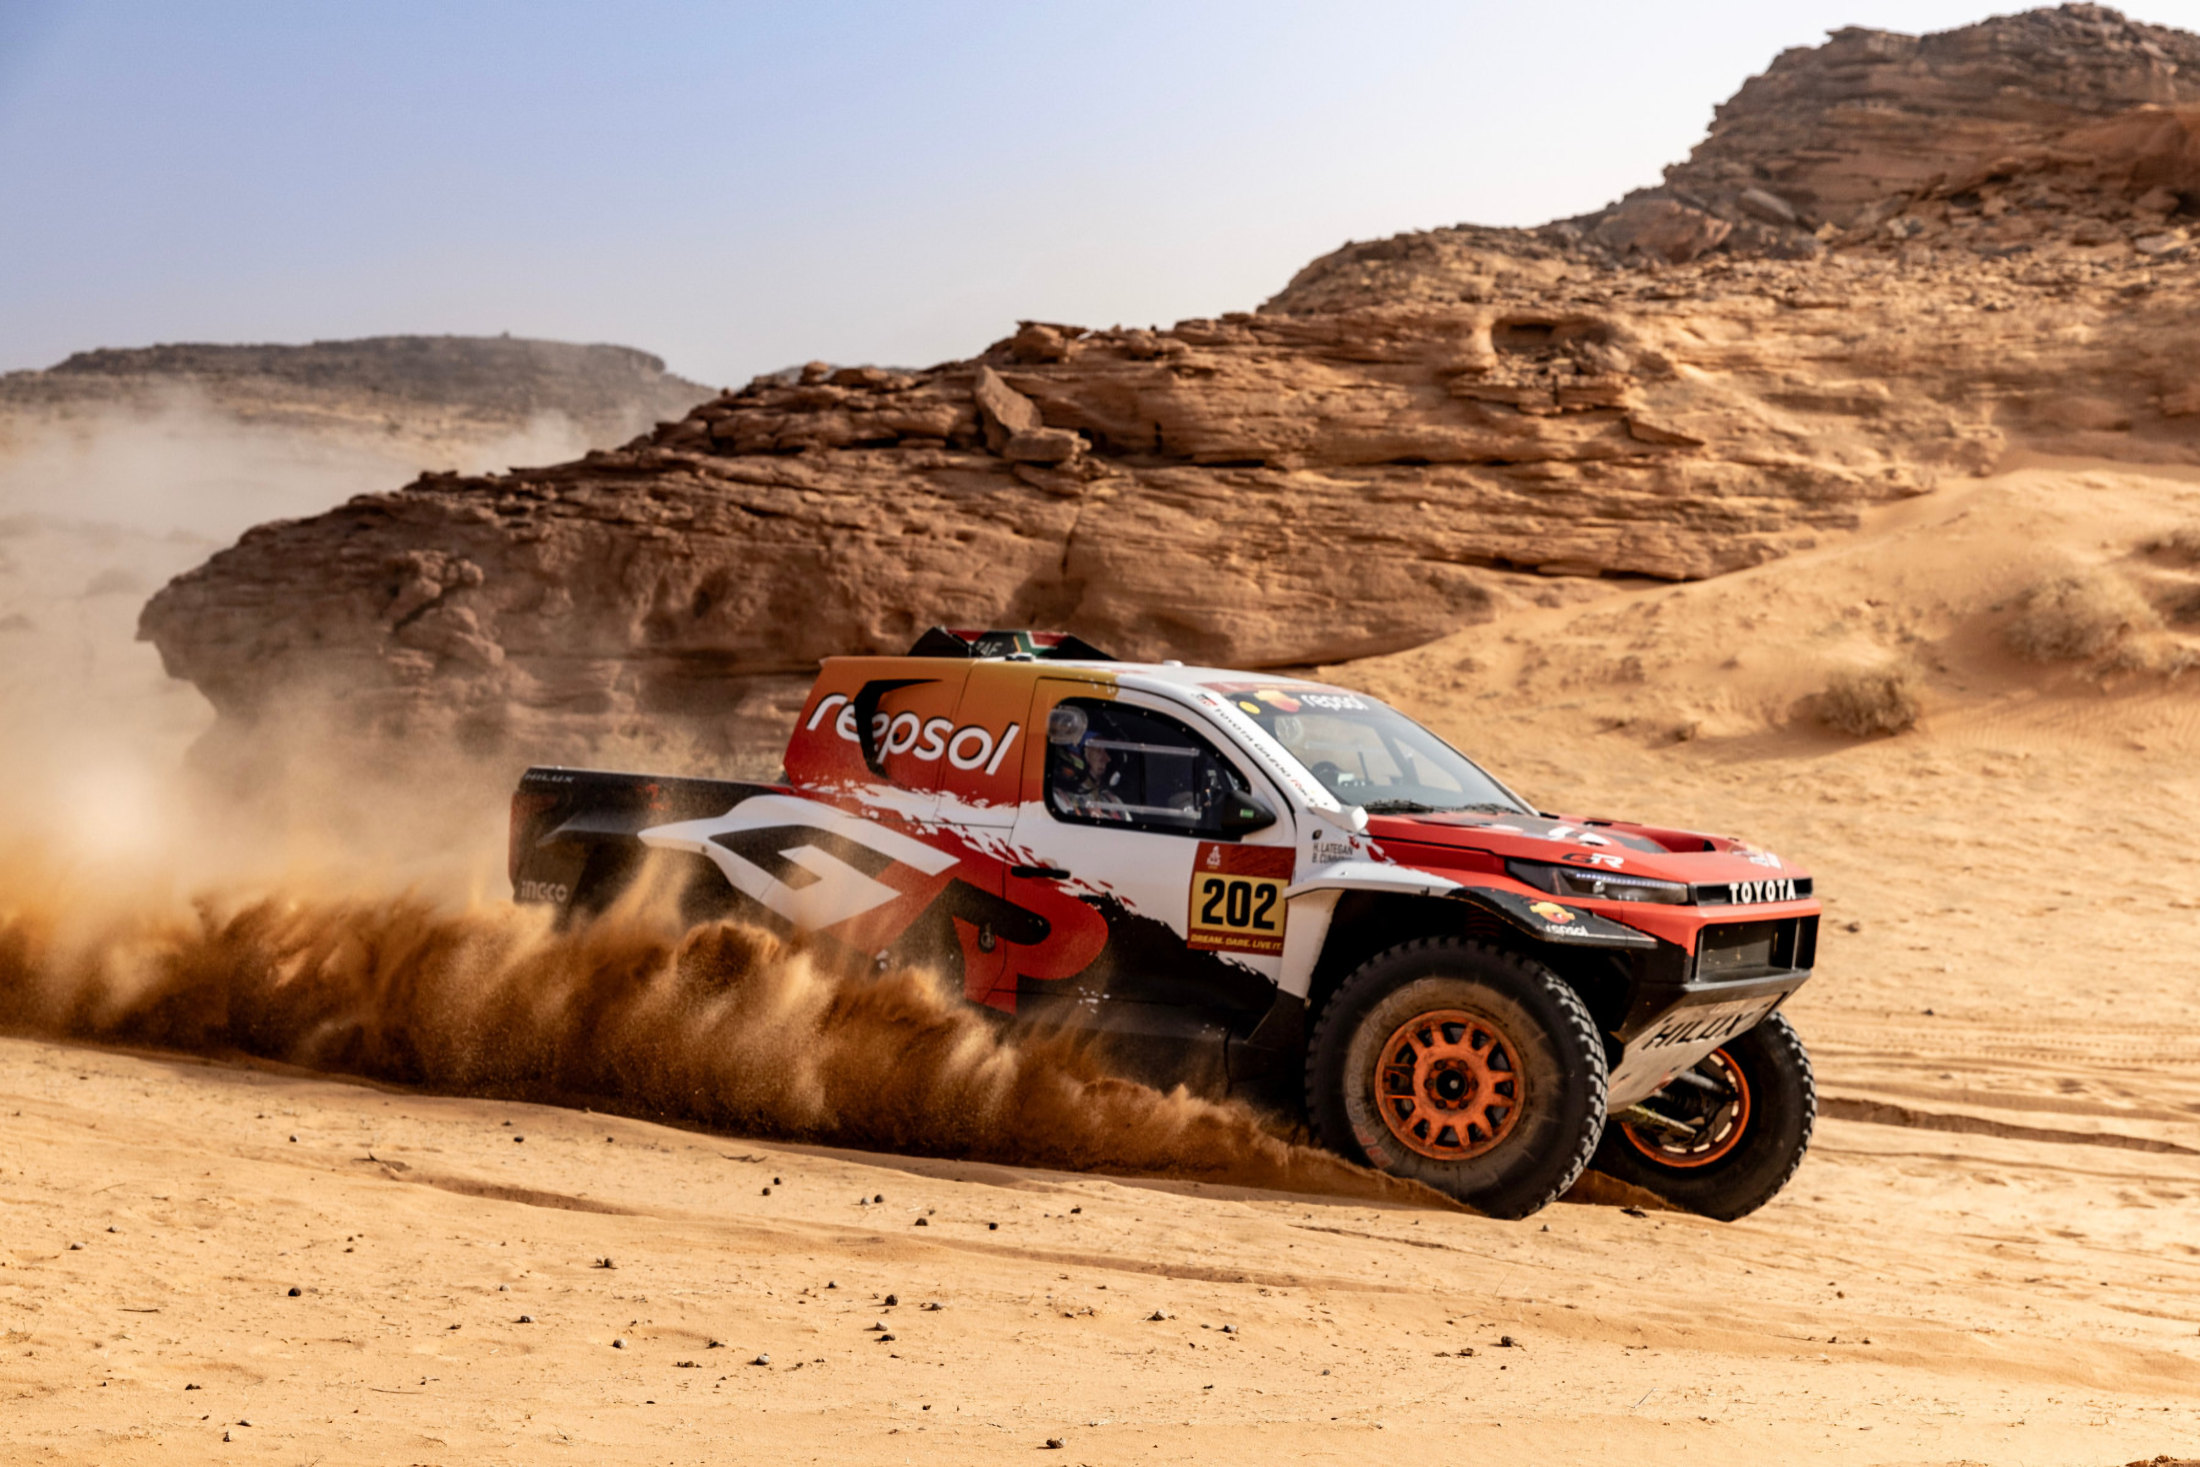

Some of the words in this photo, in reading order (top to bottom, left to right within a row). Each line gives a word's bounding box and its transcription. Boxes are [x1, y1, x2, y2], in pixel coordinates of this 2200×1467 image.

[805, 692, 1021, 777] repsol
[1561, 852, 1625, 869] GR
[1201, 878, 1278, 931] 202
[1729, 878, 1797, 906] TOYOTA
[1640, 1012, 1754, 1051] HILUX
